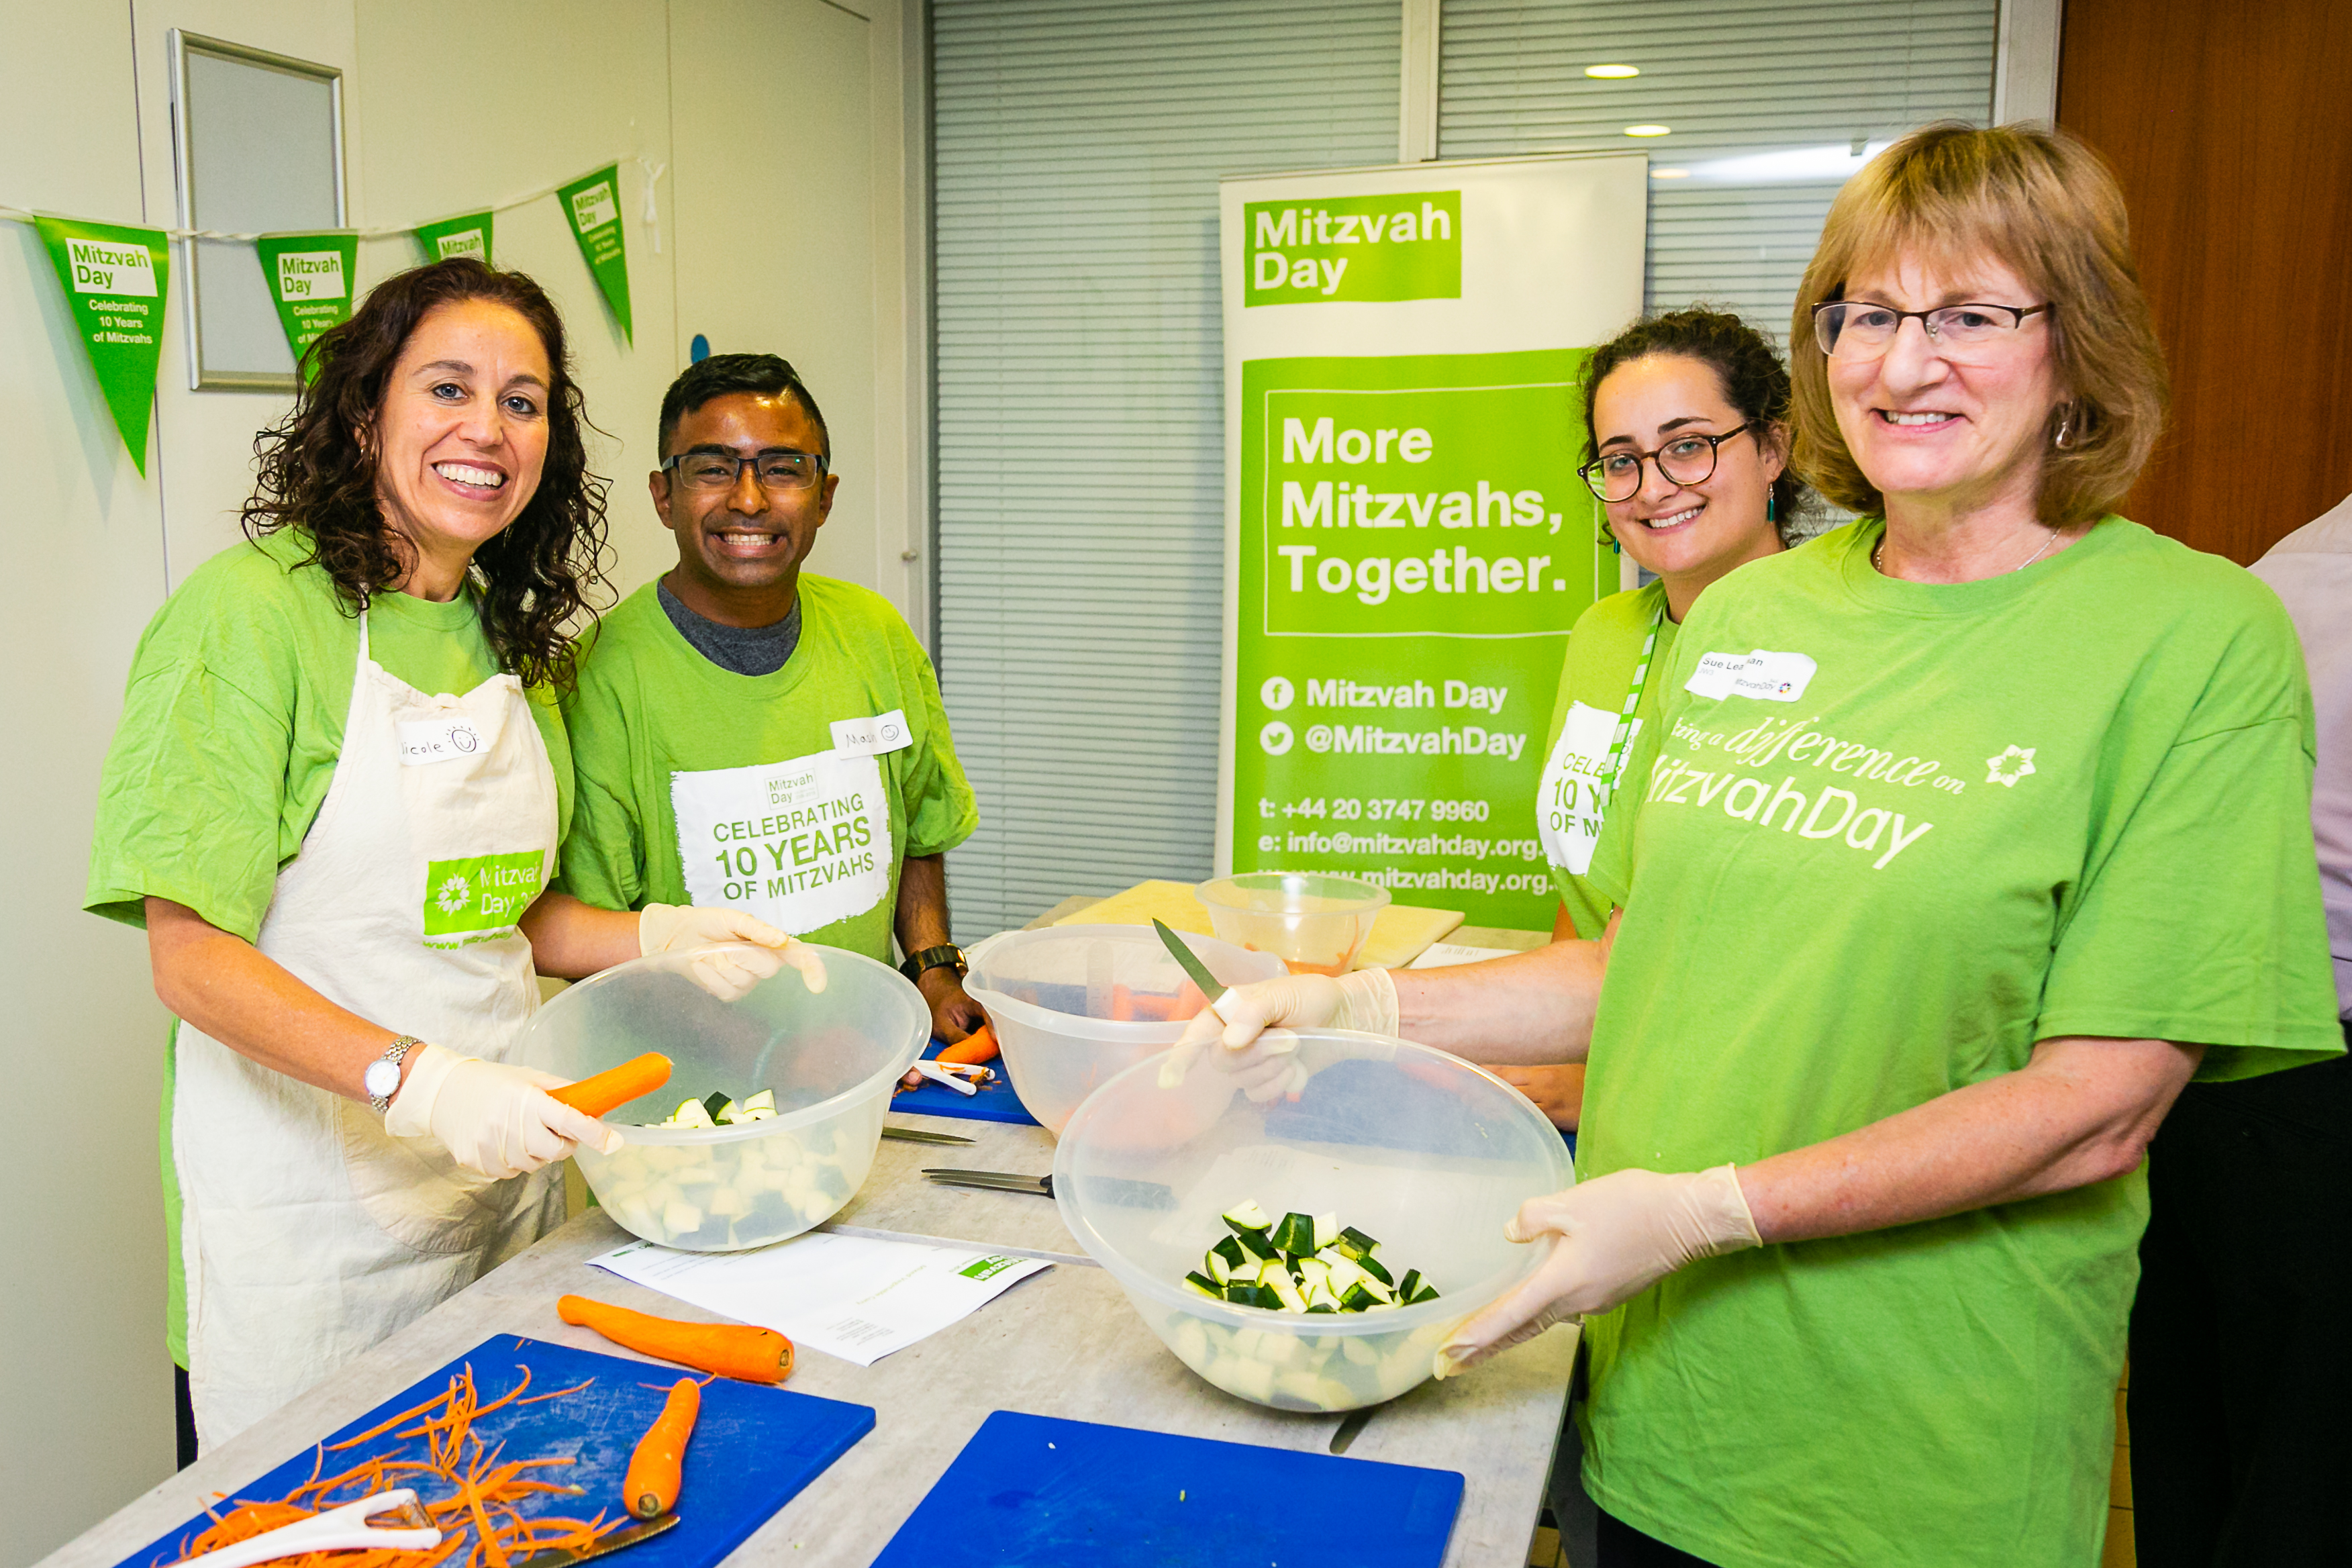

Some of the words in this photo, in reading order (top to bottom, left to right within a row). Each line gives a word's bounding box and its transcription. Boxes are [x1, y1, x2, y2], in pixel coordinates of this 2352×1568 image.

[1255, 202, 1451, 249] Mitzvah
[72, 244, 149, 268] Mitzvah
[441, 234, 482, 256] Mitzvah
[77, 265, 113, 289] Day
[283, 256, 340, 275] Mitzvah
[1254, 252, 1349, 295] Day
[284, 277, 311, 295] Day
[89, 299, 149, 315] Celebrating
[99, 316, 113, 328] 10
[114, 316, 144, 328] Years
[93, 332, 105, 343] of
[107, 332, 153, 344] Mitzvahs
[1282, 417, 1434, 464] More
[1281, 481, 1564, 535] Mitzvahs,
[1277, 545, 1566, 605] Together.
[1703, 657, 1724, 669] Sue
[1306, 678, 1436, 708] Mitzvah
[1444, 679, 1509, 714] Day
[1306, 725, 1527, 761] @MitzvahDay
[1671, 717, 1710, 750] king
[1708, 733, 1725, 746] a
[1724, 716, 1941, 788] difference
[1932, 773, 1966, 796] on
[769, 773, 814, 792] Mitzvah
[1555, 777, 1577, 810] 10
[771, 793, 792, 804] Day
[1258, 797, 1275, 818] t:
[1282, 797, 1326, 819] +44
[1332, 798, 1361, 820] 20
[1367, 799, 1426, 820] 3747
[1431, 799, 1489, 822] 9960
[714, 793, 865, 842] CELEBRATING
[1551, 811, 1575, 834] OF
[716, 846, 758, 878] 10
[764, 816, 871, 871] YEARS
[1258, 833, 1281, 852] e:
[1288, 831, 1545, 861] info@mitzvahday.org.
[724, 881, 757, 900] OF
[767, 852, 874, 899] MITZVAHS
[481, 893, 515, 918] Day
